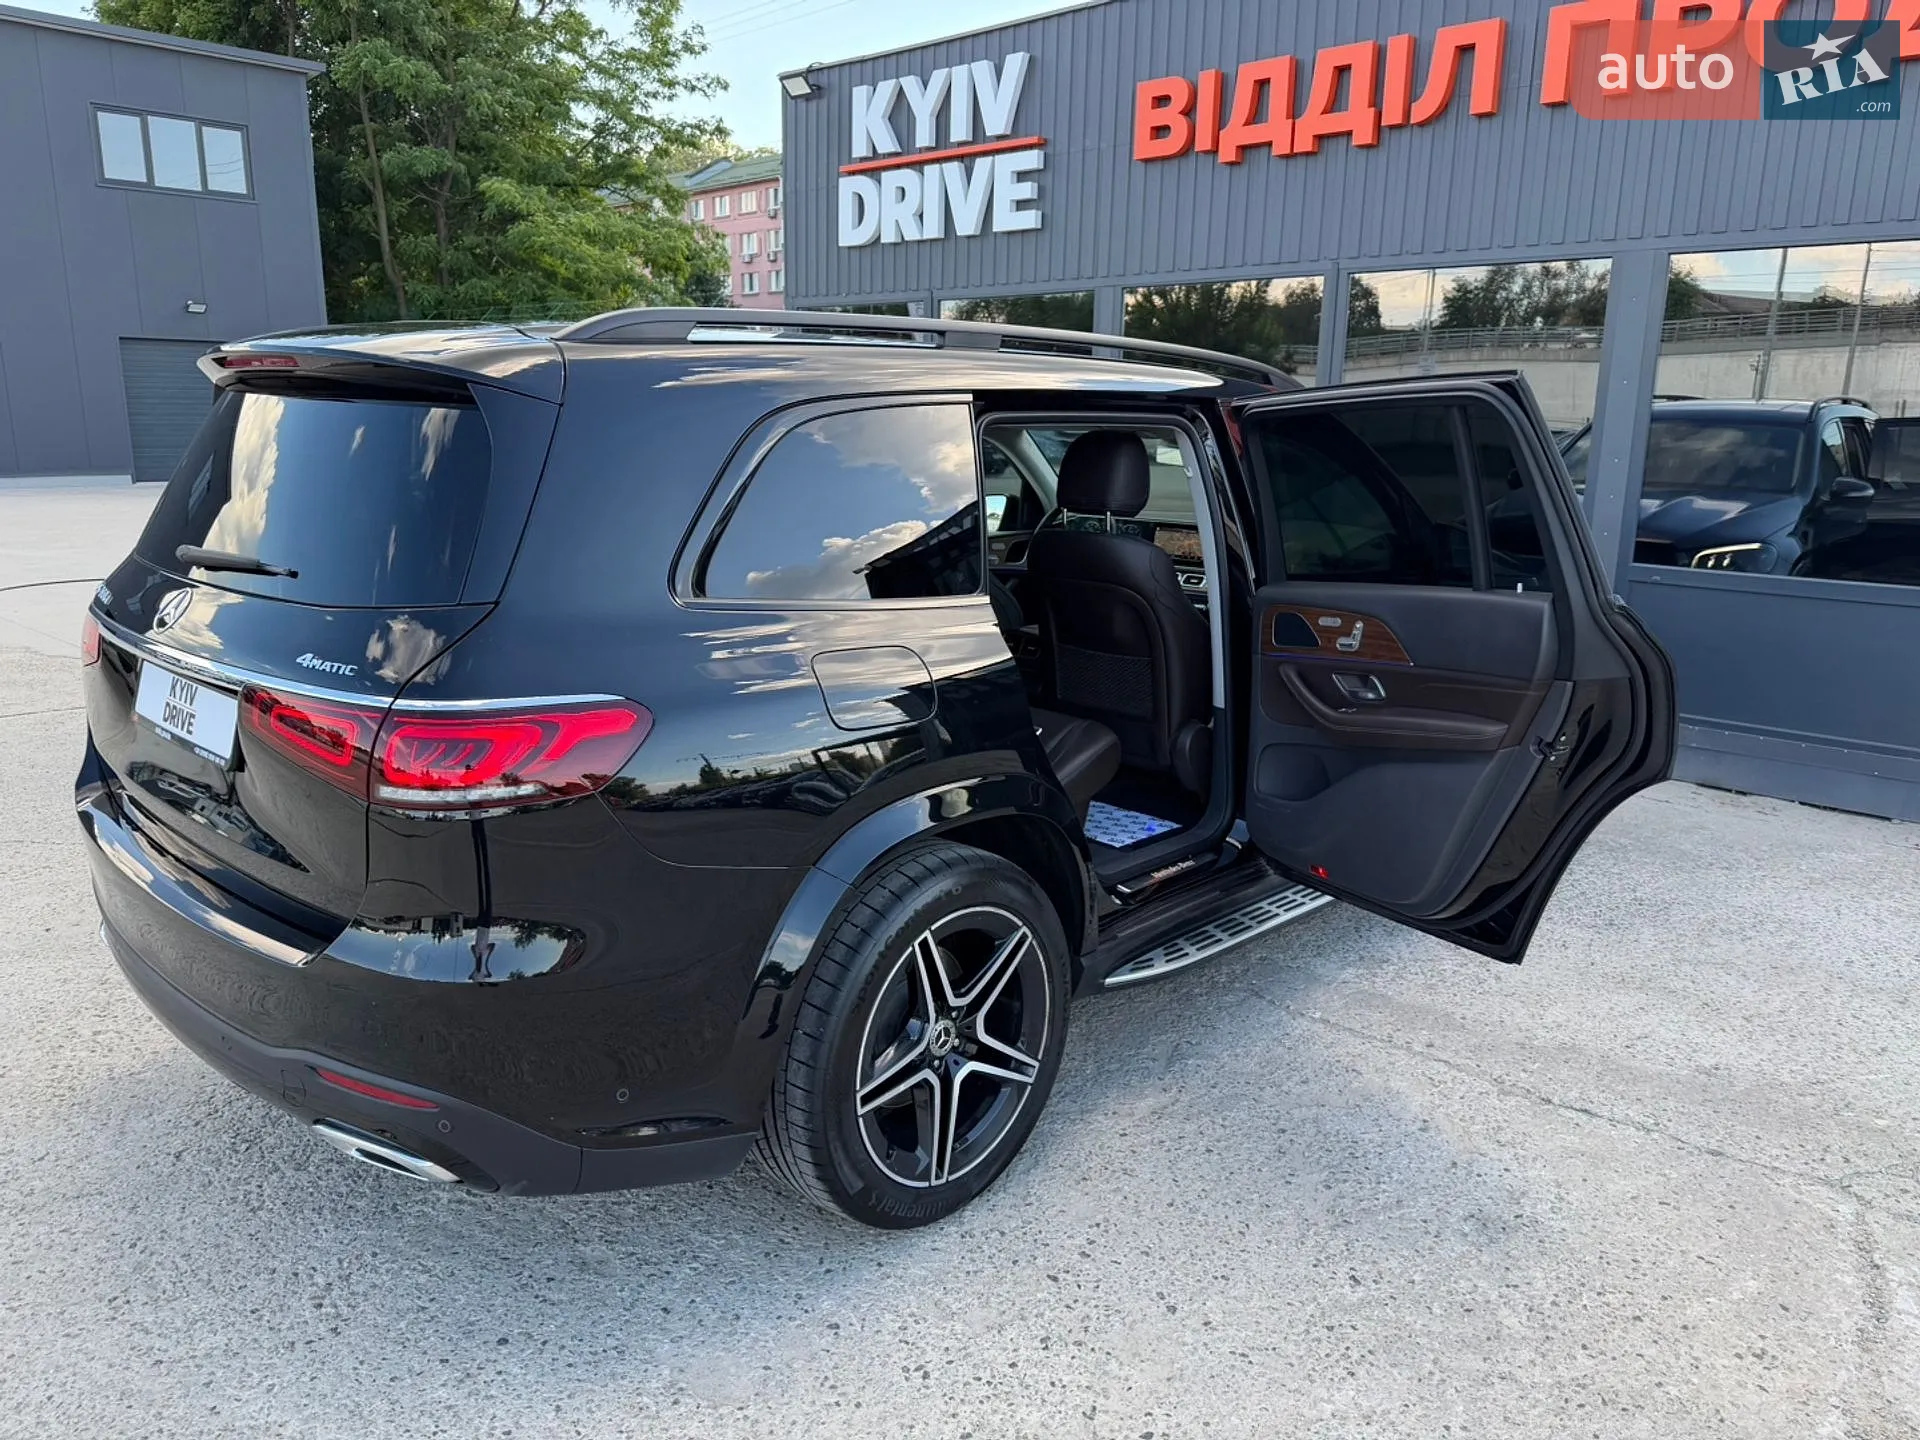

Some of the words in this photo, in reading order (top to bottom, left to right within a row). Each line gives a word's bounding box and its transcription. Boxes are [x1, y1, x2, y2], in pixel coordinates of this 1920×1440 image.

[852, 52, 1030, 158] KYIV
[1133, 17, 1507, 164] ВІДДІЛ
[1541, 0, 1920, 106] ПРО
[838, 149, 1044, 246] DRIVE
[170, 676, 198, 706] KYIV
[296, 653, 358, 676] 4MATIC
[163, 701, 196, 735] DRIVE
